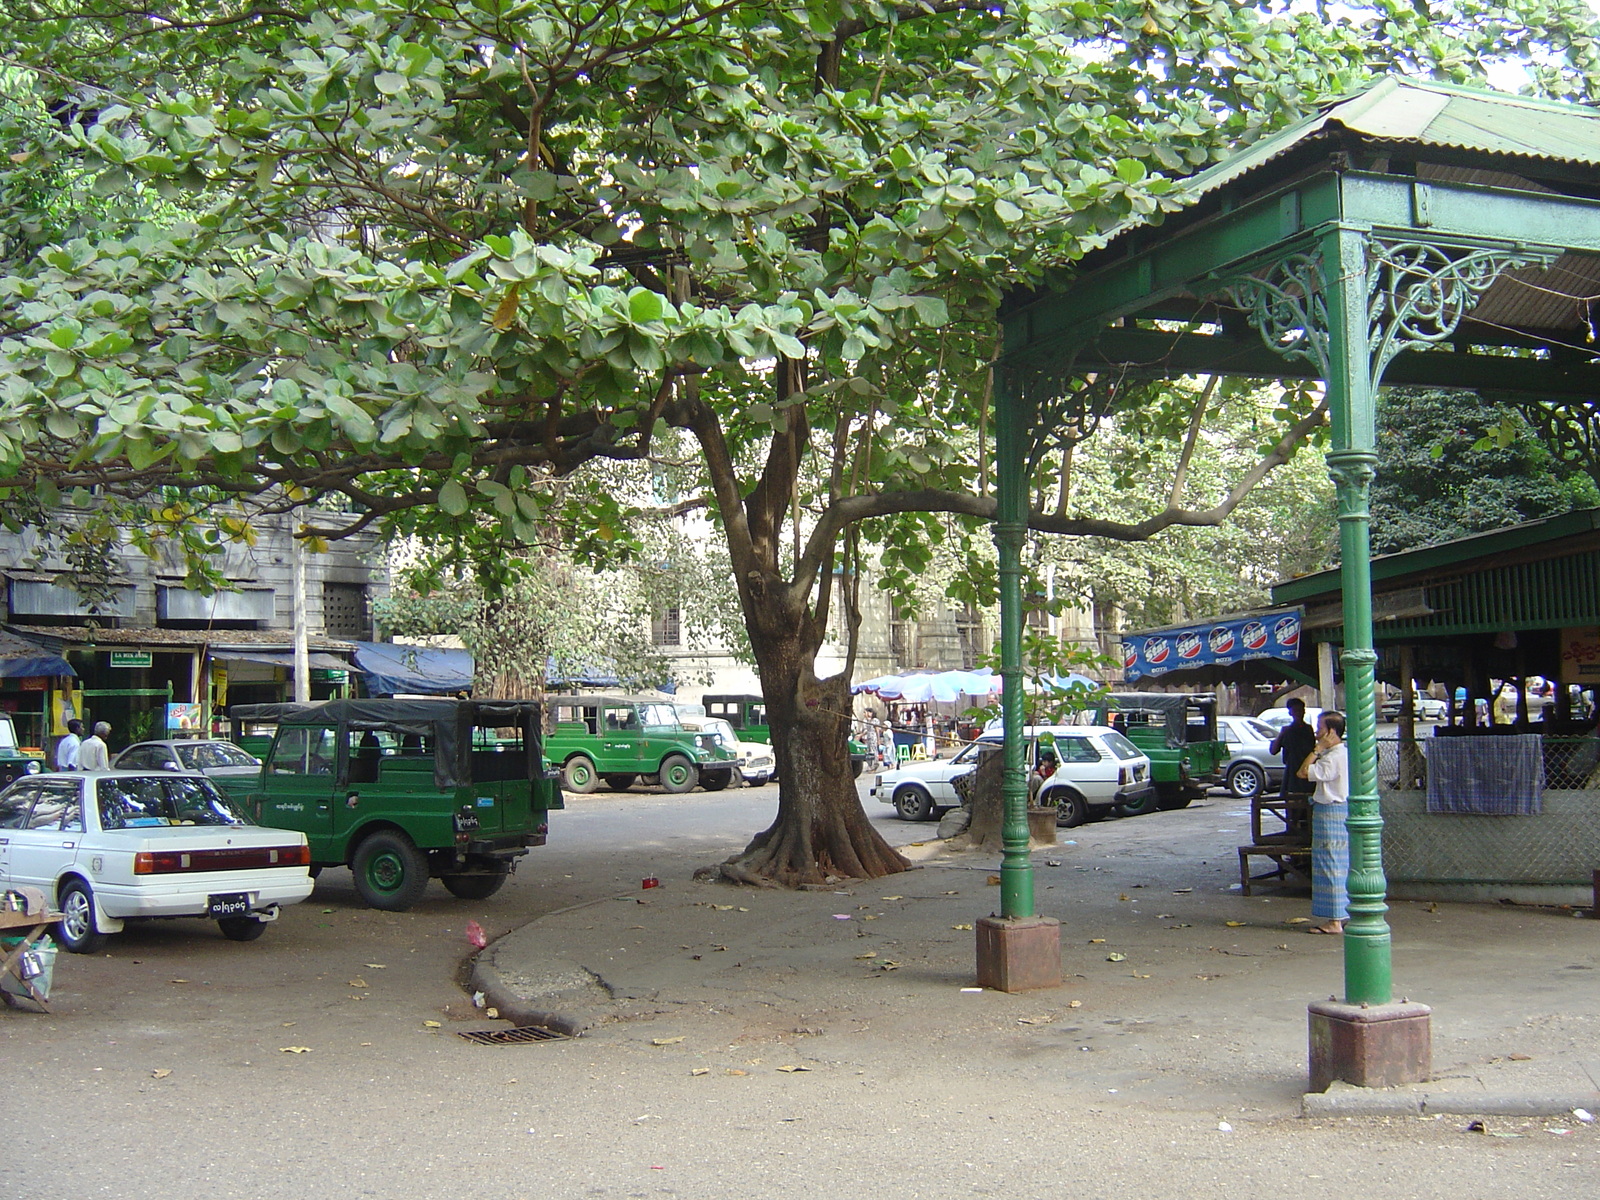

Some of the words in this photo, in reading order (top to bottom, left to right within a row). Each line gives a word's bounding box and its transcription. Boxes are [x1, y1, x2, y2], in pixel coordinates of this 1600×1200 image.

[1210, 630, 1233, 652] Star
[1243, 625, 1266, 648] Star
[1276, 621, 1299, 644] Star
[1125, 645, 1136, 659] ar
[1145, 640, 1168, 662] Star
[1178, 635, 1200, 657] Star
